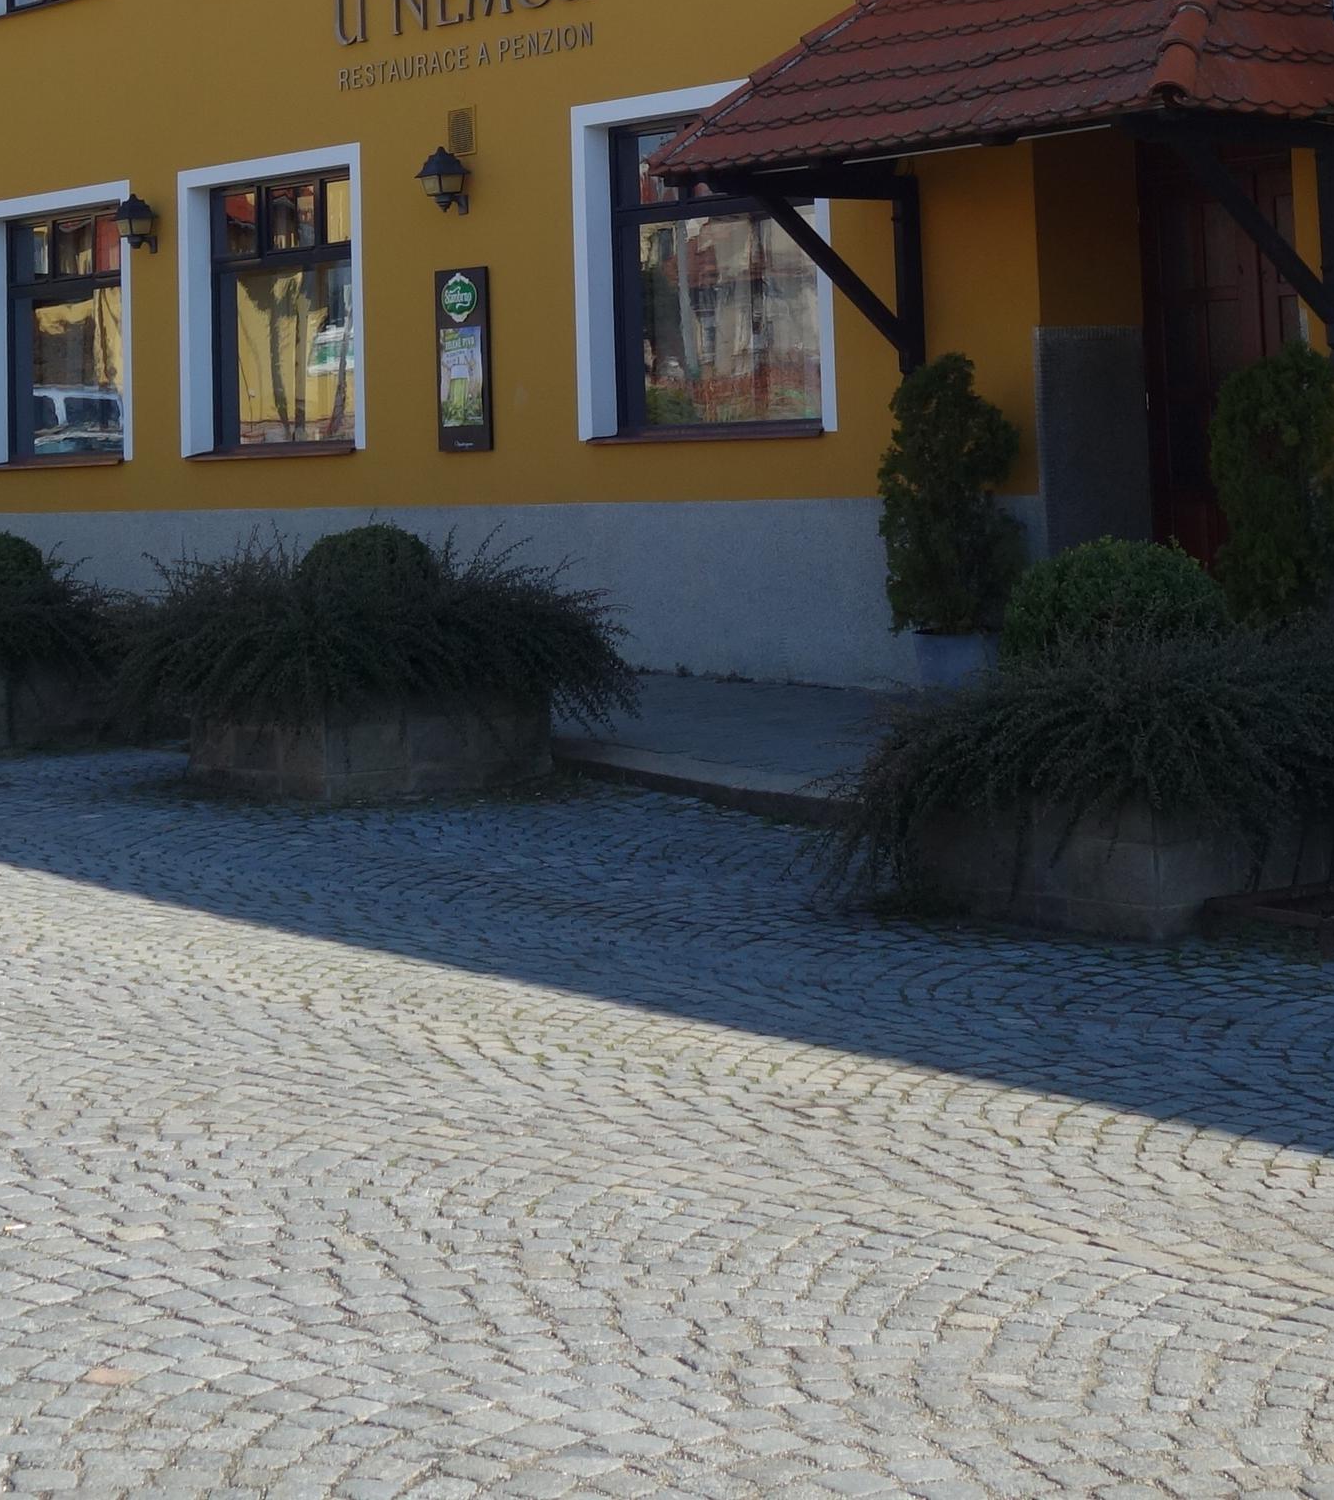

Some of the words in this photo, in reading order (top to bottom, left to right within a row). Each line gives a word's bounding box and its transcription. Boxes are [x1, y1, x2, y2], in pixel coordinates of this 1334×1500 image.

[338, 46, 470, 92] RESTAURACE
[476, 43, 491, 67] A
[497, 21, 594, 62] PENZION
